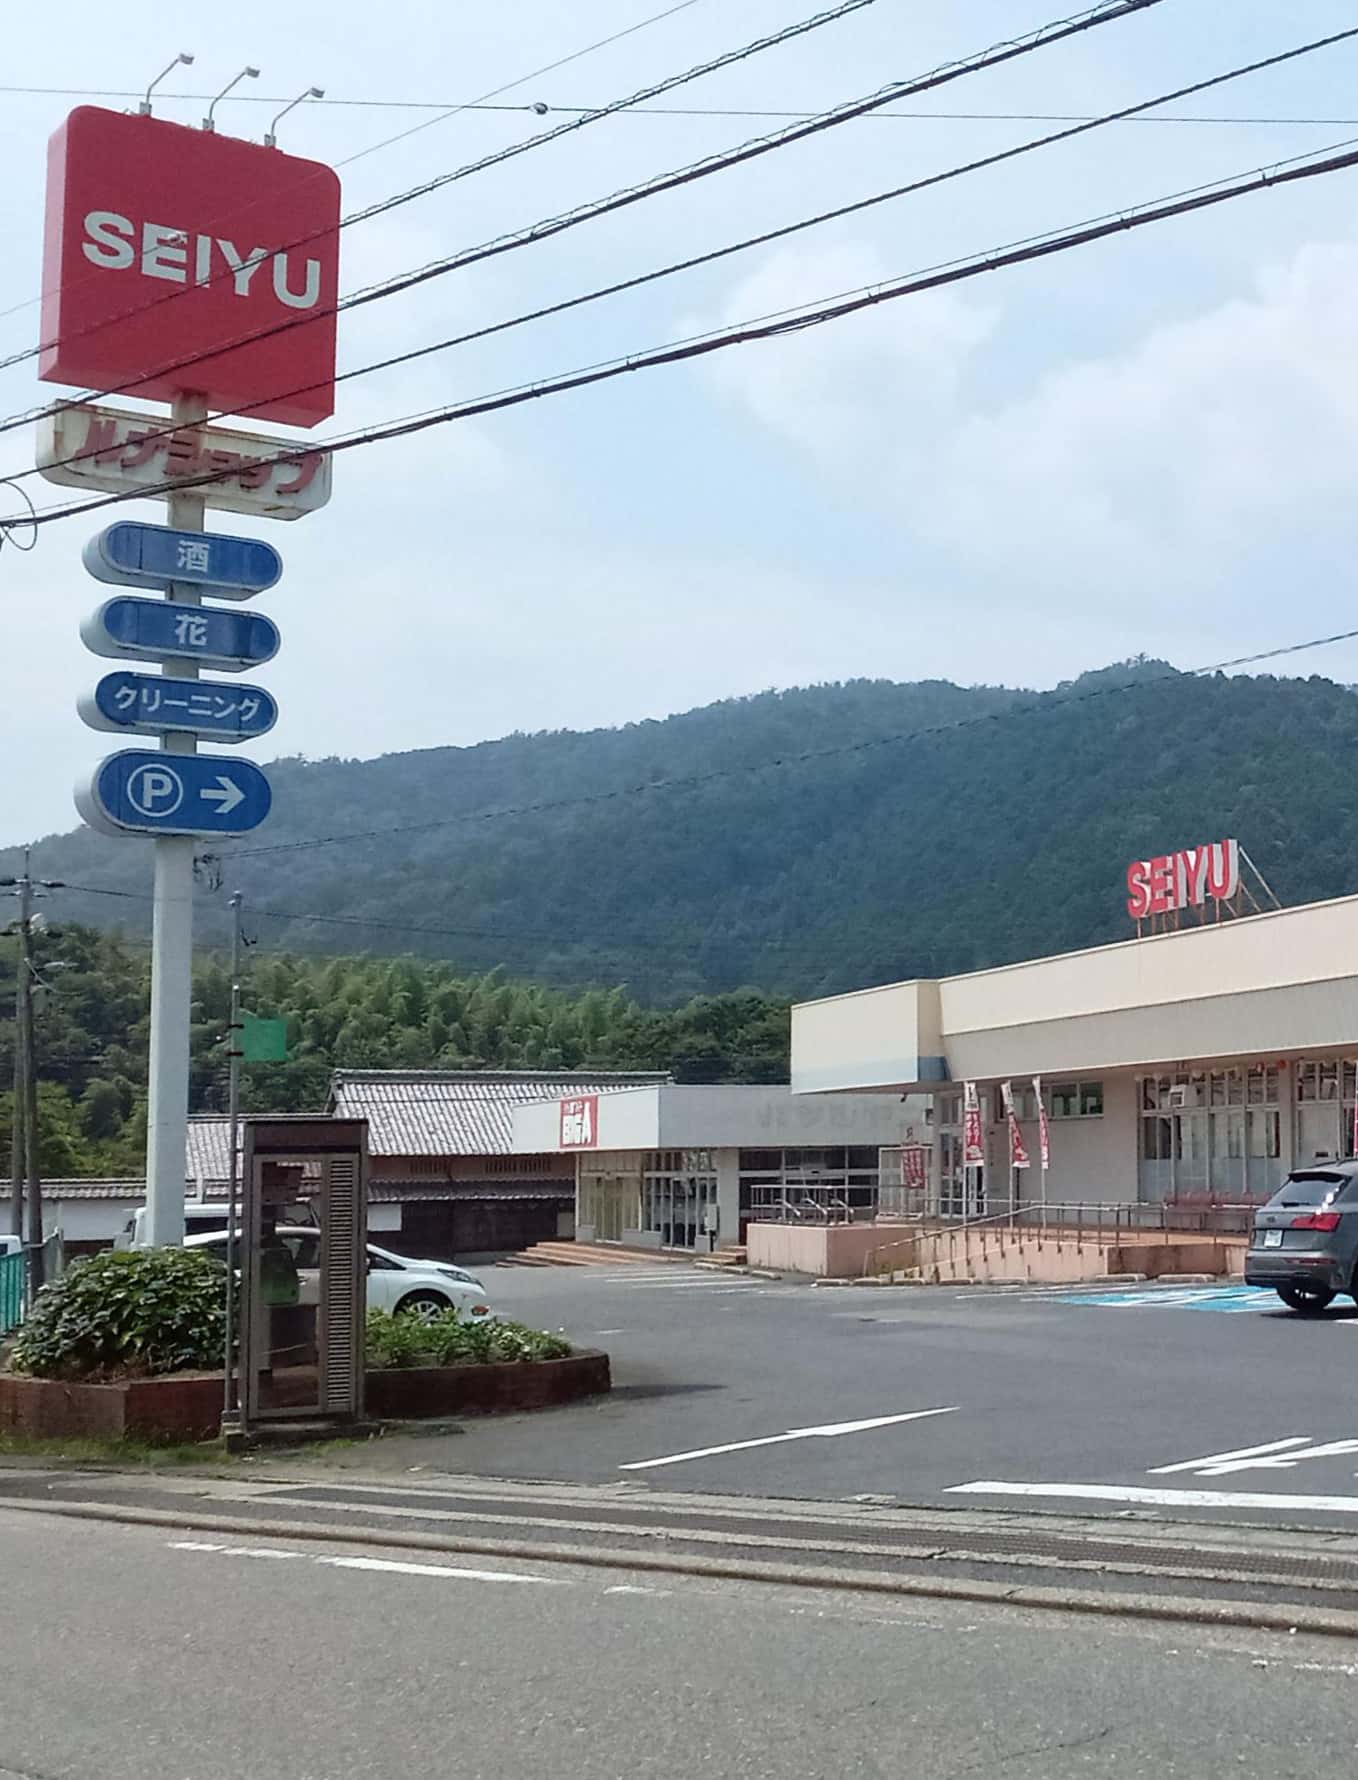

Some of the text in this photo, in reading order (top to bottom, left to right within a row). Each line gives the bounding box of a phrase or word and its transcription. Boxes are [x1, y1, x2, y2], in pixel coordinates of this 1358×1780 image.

[82, 209, 320, 310] SEIYU
[177, 541, 208, 573] 酒
[175, 614, 208, 647] 花
[115, 686, 259, 722] クリーニング
[1127, 839, 1238, 919] SEIYU
